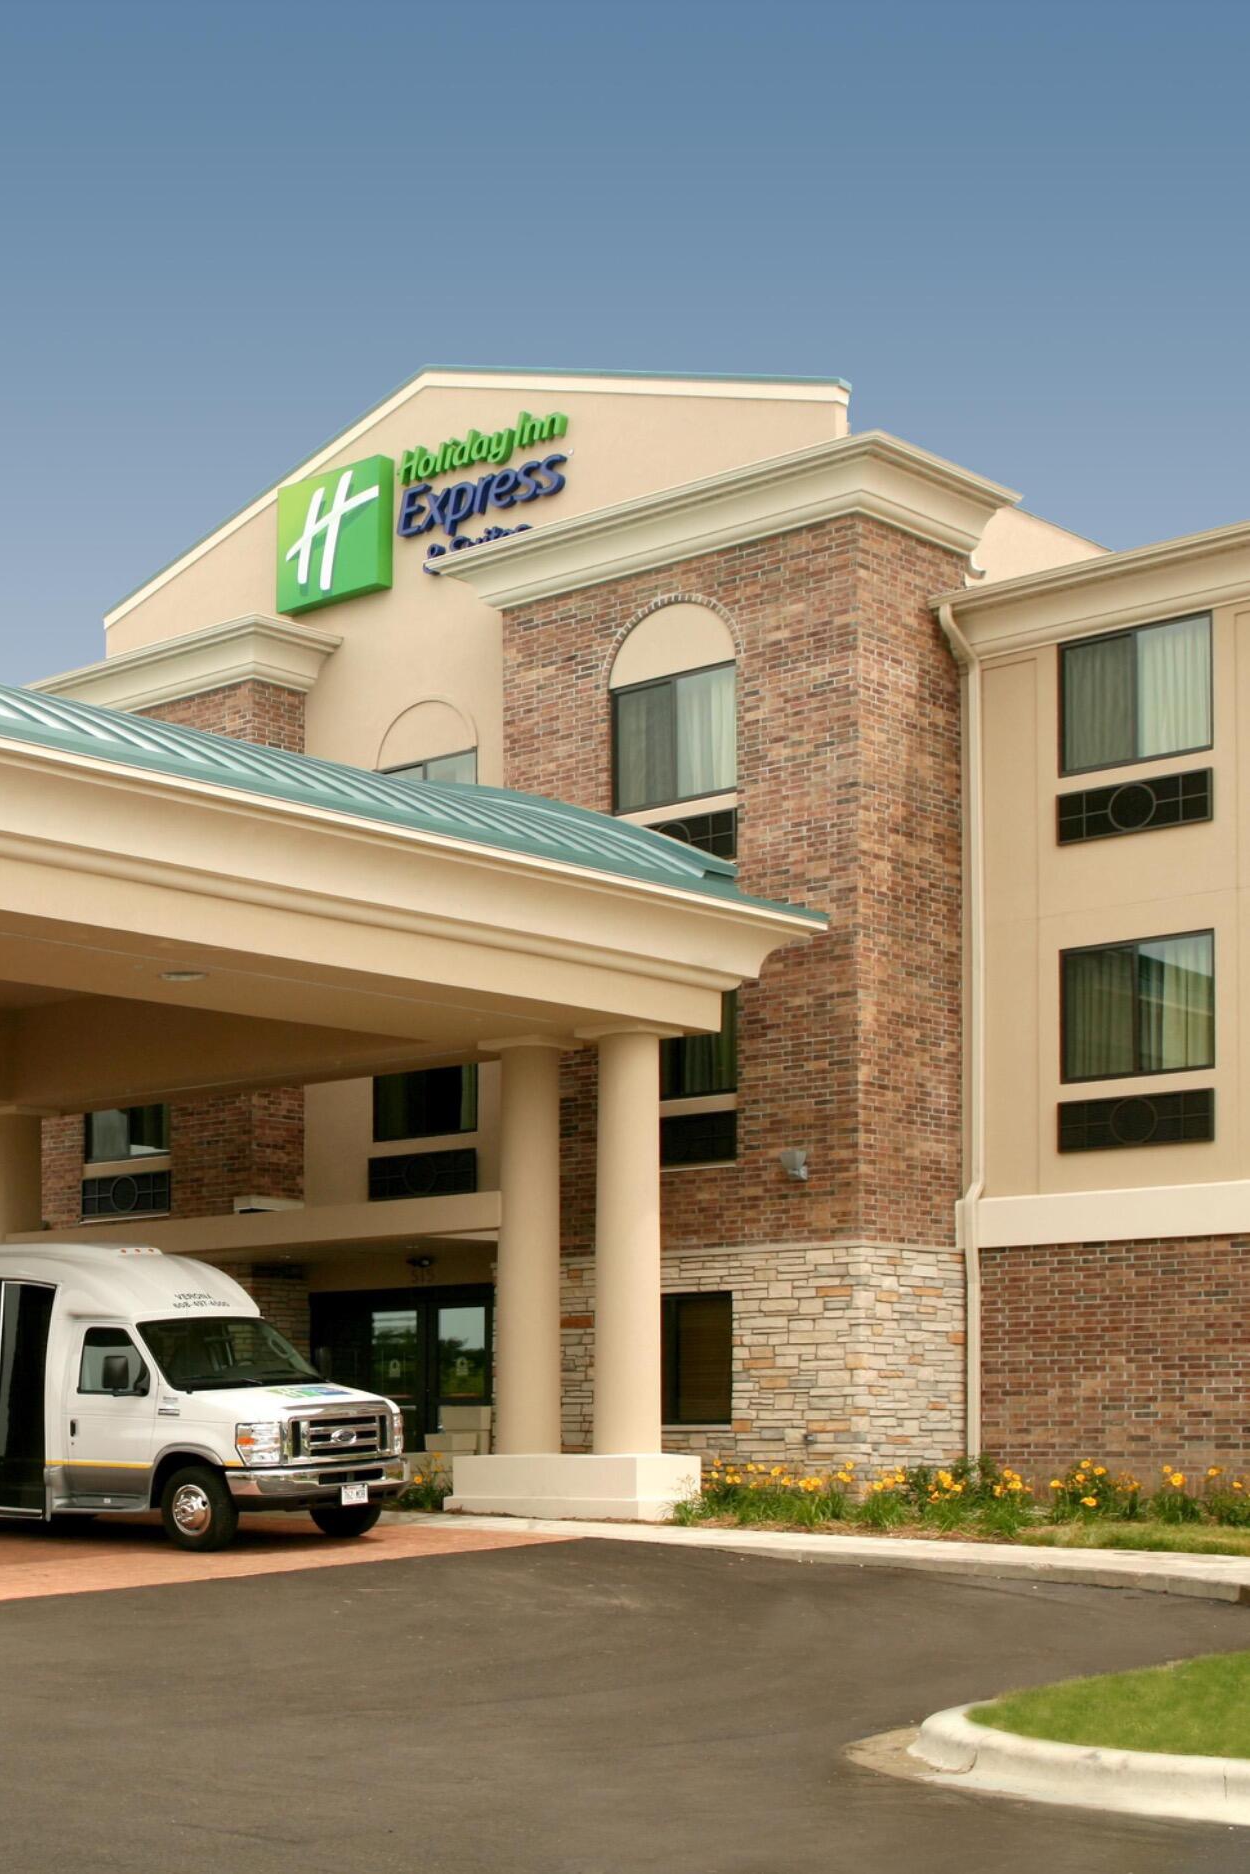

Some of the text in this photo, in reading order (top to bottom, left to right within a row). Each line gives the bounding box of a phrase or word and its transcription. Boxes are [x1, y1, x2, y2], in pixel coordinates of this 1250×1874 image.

[400, 410, 568, 486] Holiday Inn
[397, 454, 568, 538] Express
